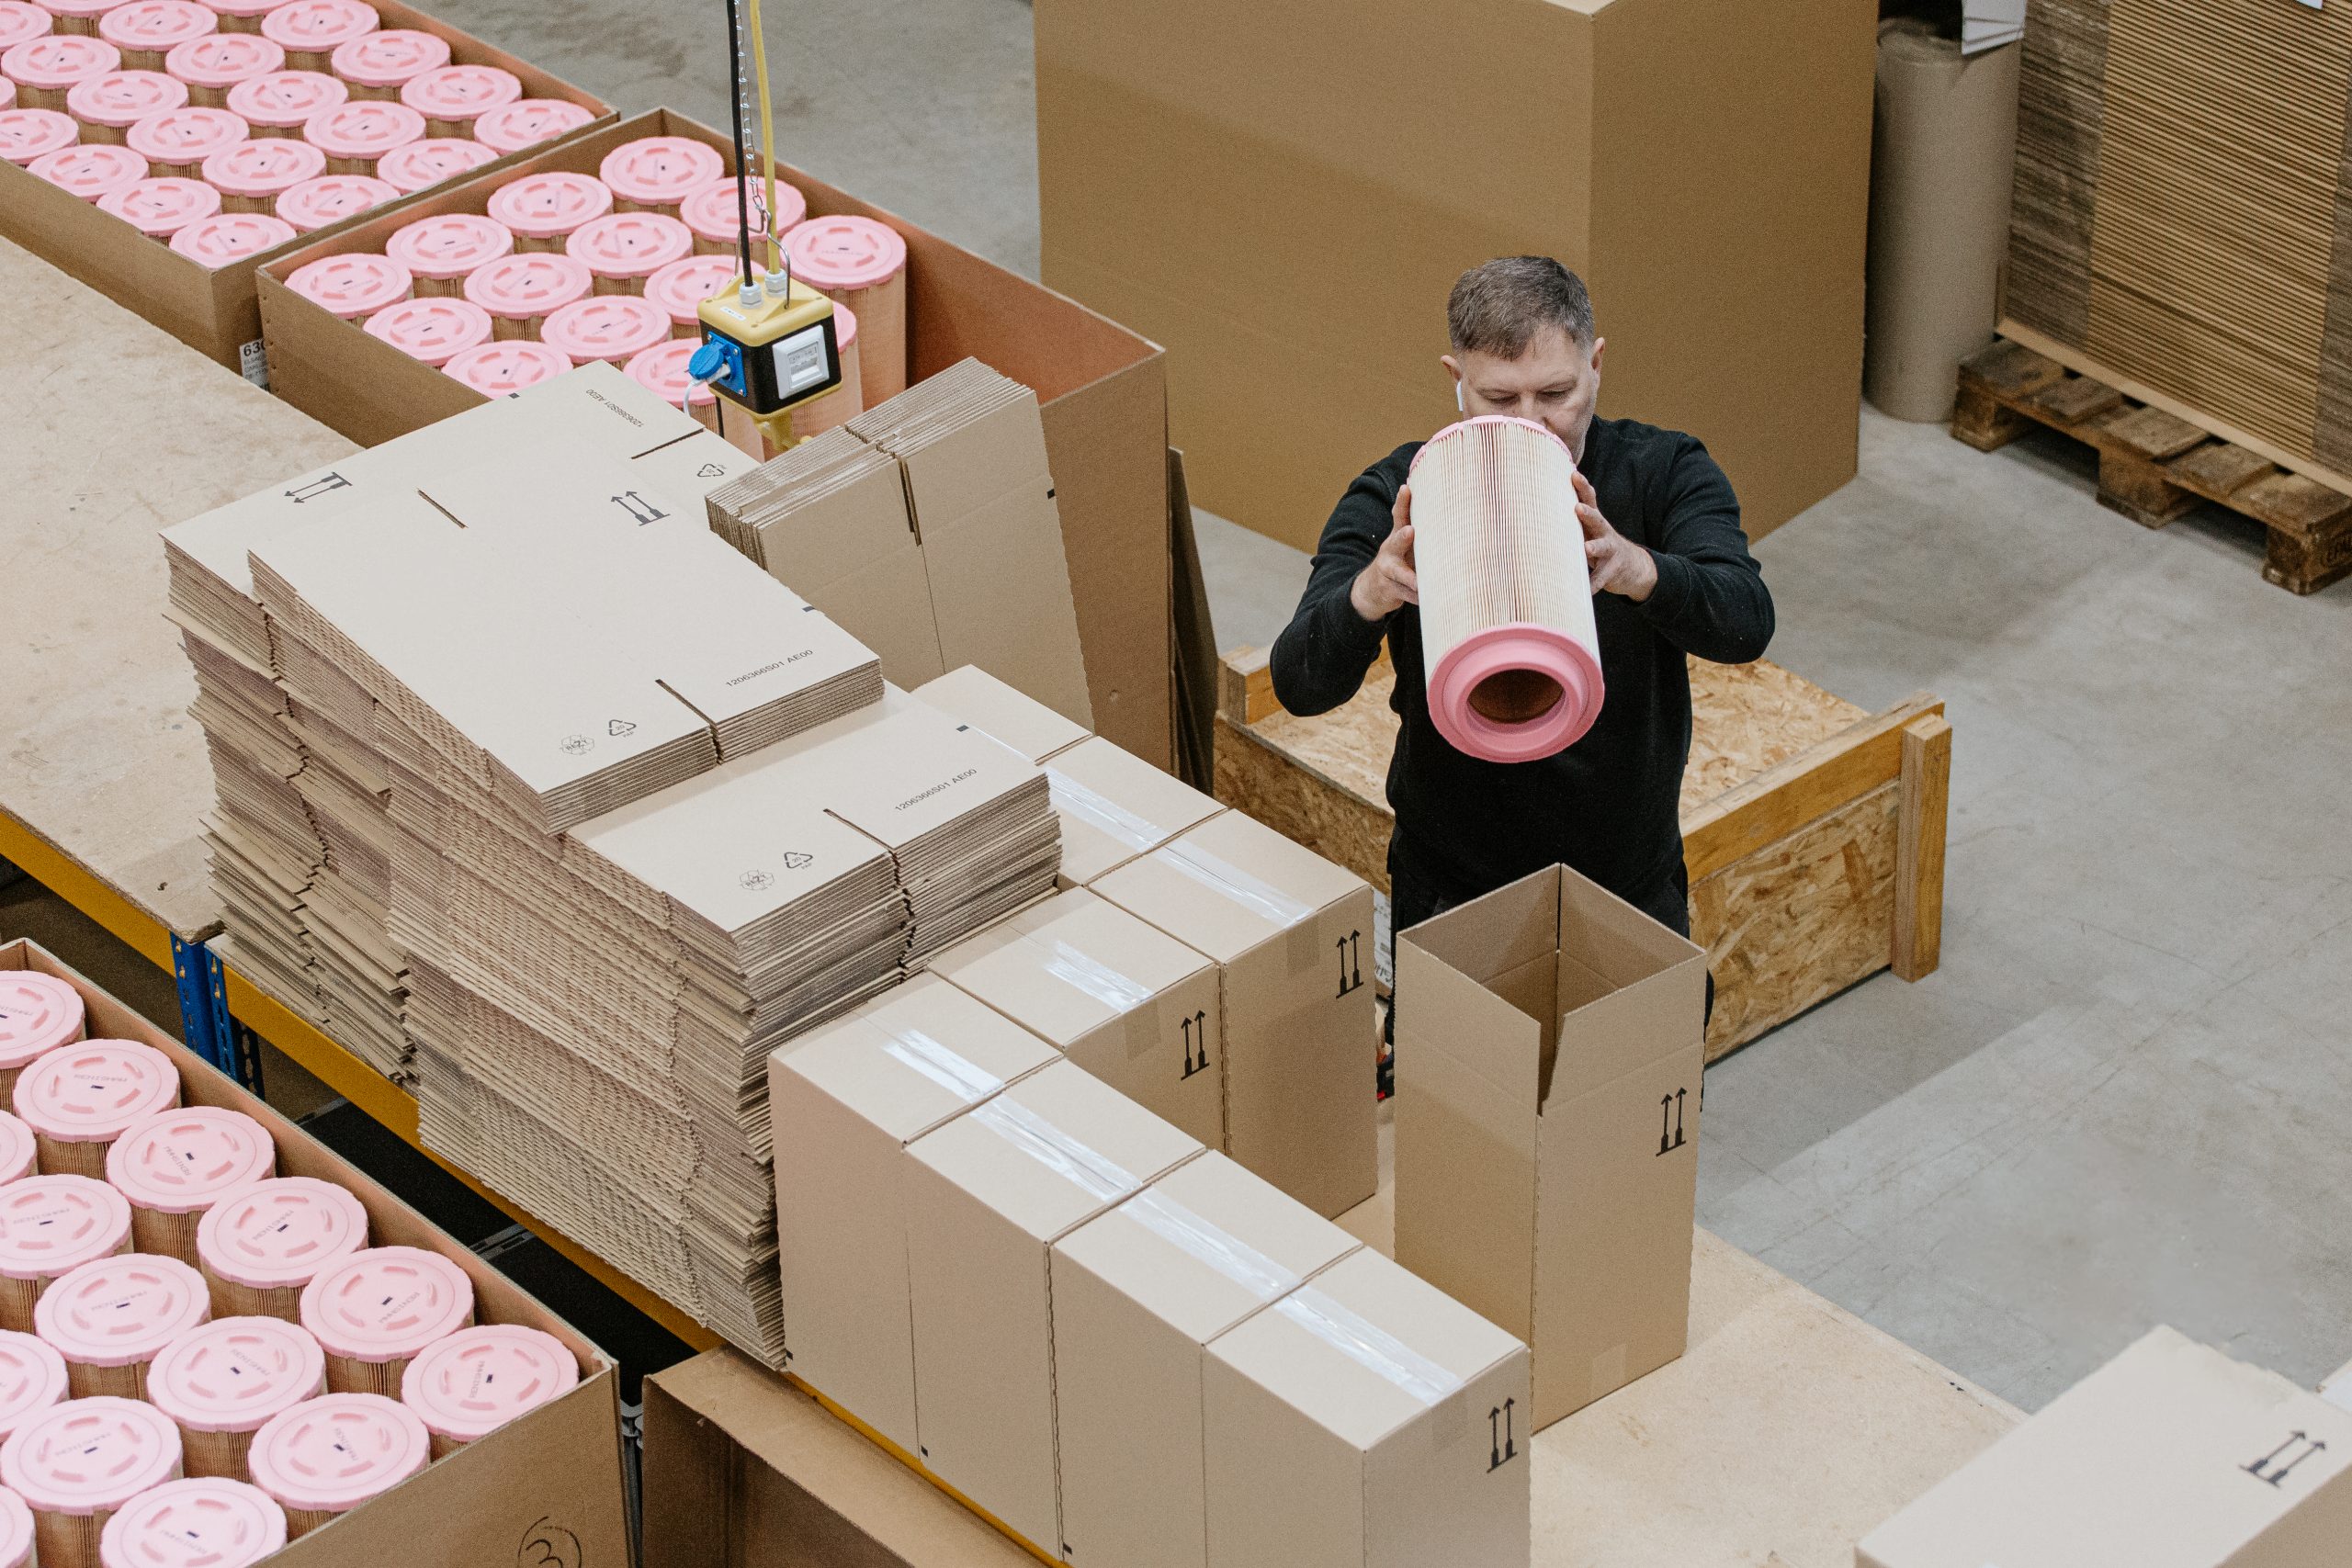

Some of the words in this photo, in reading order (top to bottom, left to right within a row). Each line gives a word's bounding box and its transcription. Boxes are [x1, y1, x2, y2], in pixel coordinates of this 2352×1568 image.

[585, 389, 606, 402] AE00
[726, 661, 785, 687] 1206366S01
[787, 649, 813, 663] AE00
[895, 782, 951, 811] 1206366S01
[952, 768, 978, 784] AE00
